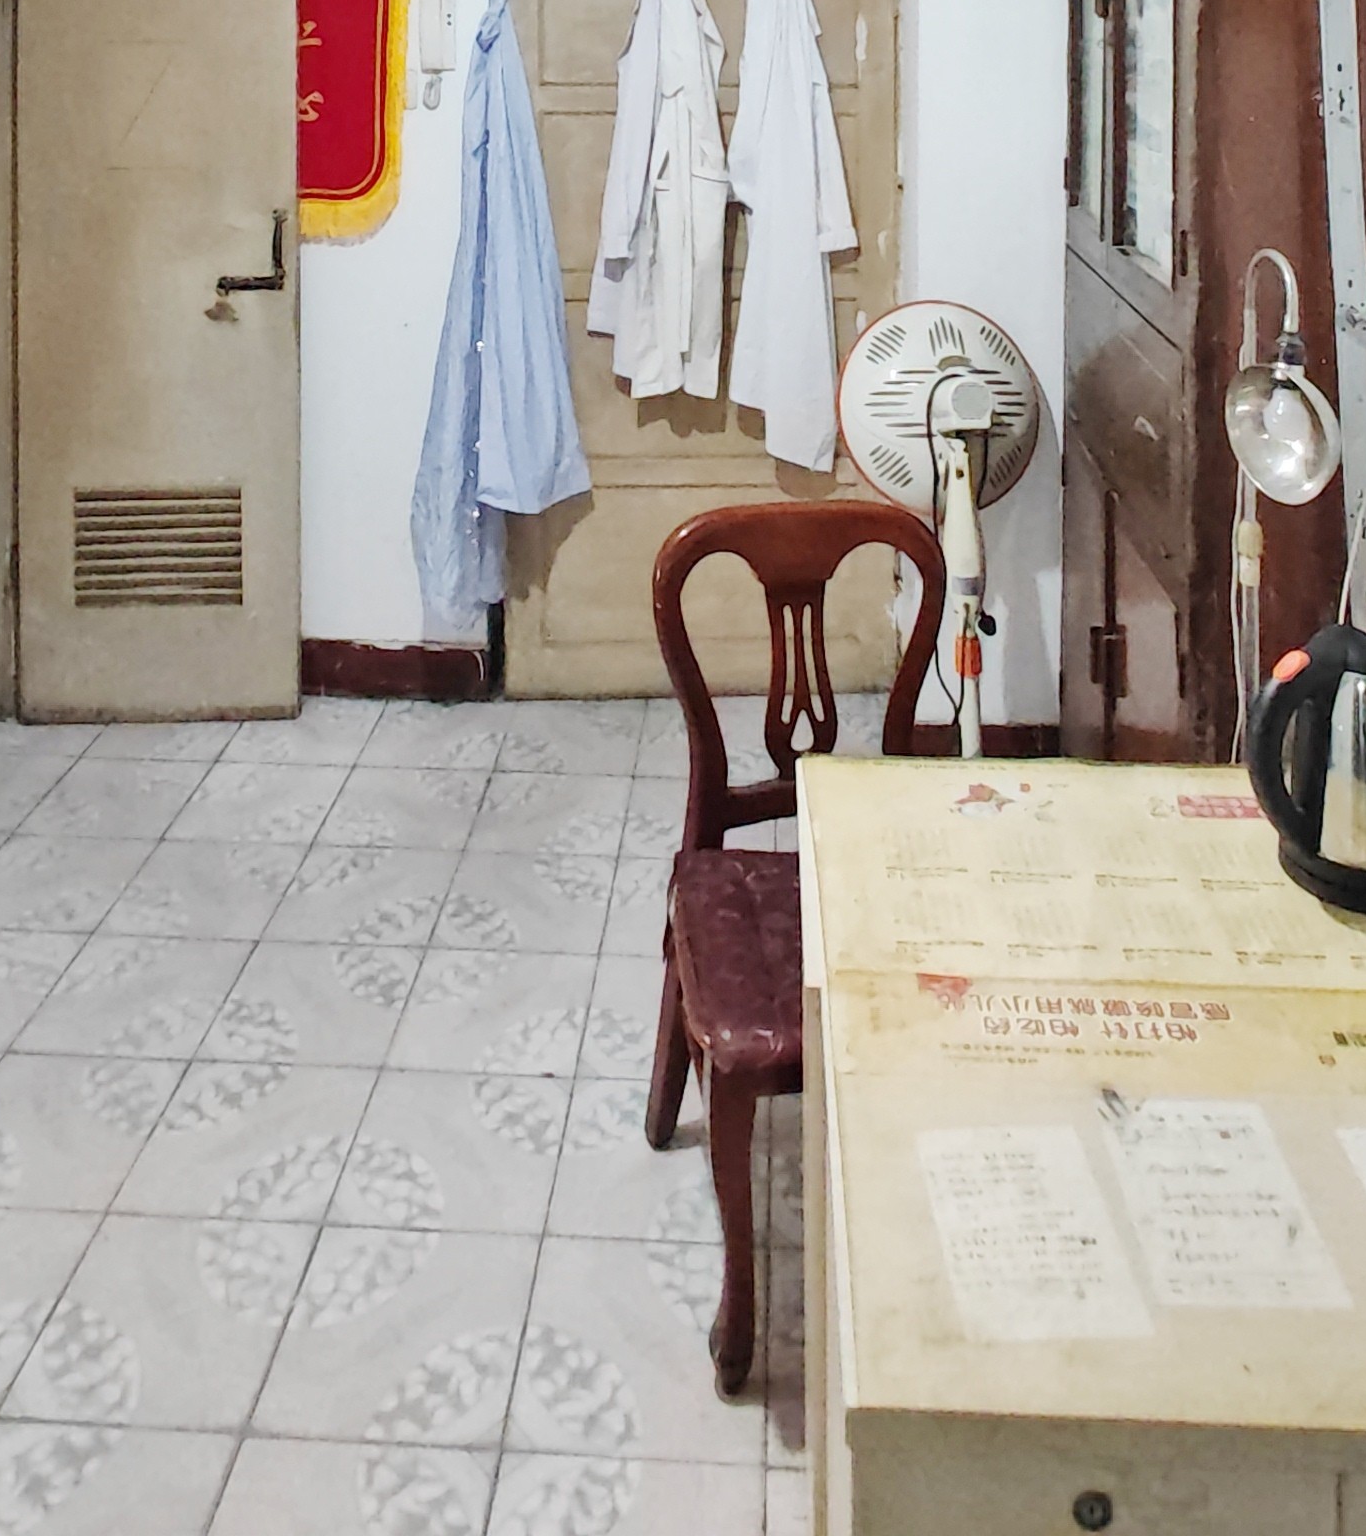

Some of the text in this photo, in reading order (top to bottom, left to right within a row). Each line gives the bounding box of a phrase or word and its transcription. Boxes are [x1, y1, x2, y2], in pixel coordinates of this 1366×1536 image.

[981, 1014, 1200, 1046] 怕打针 怕吃药
